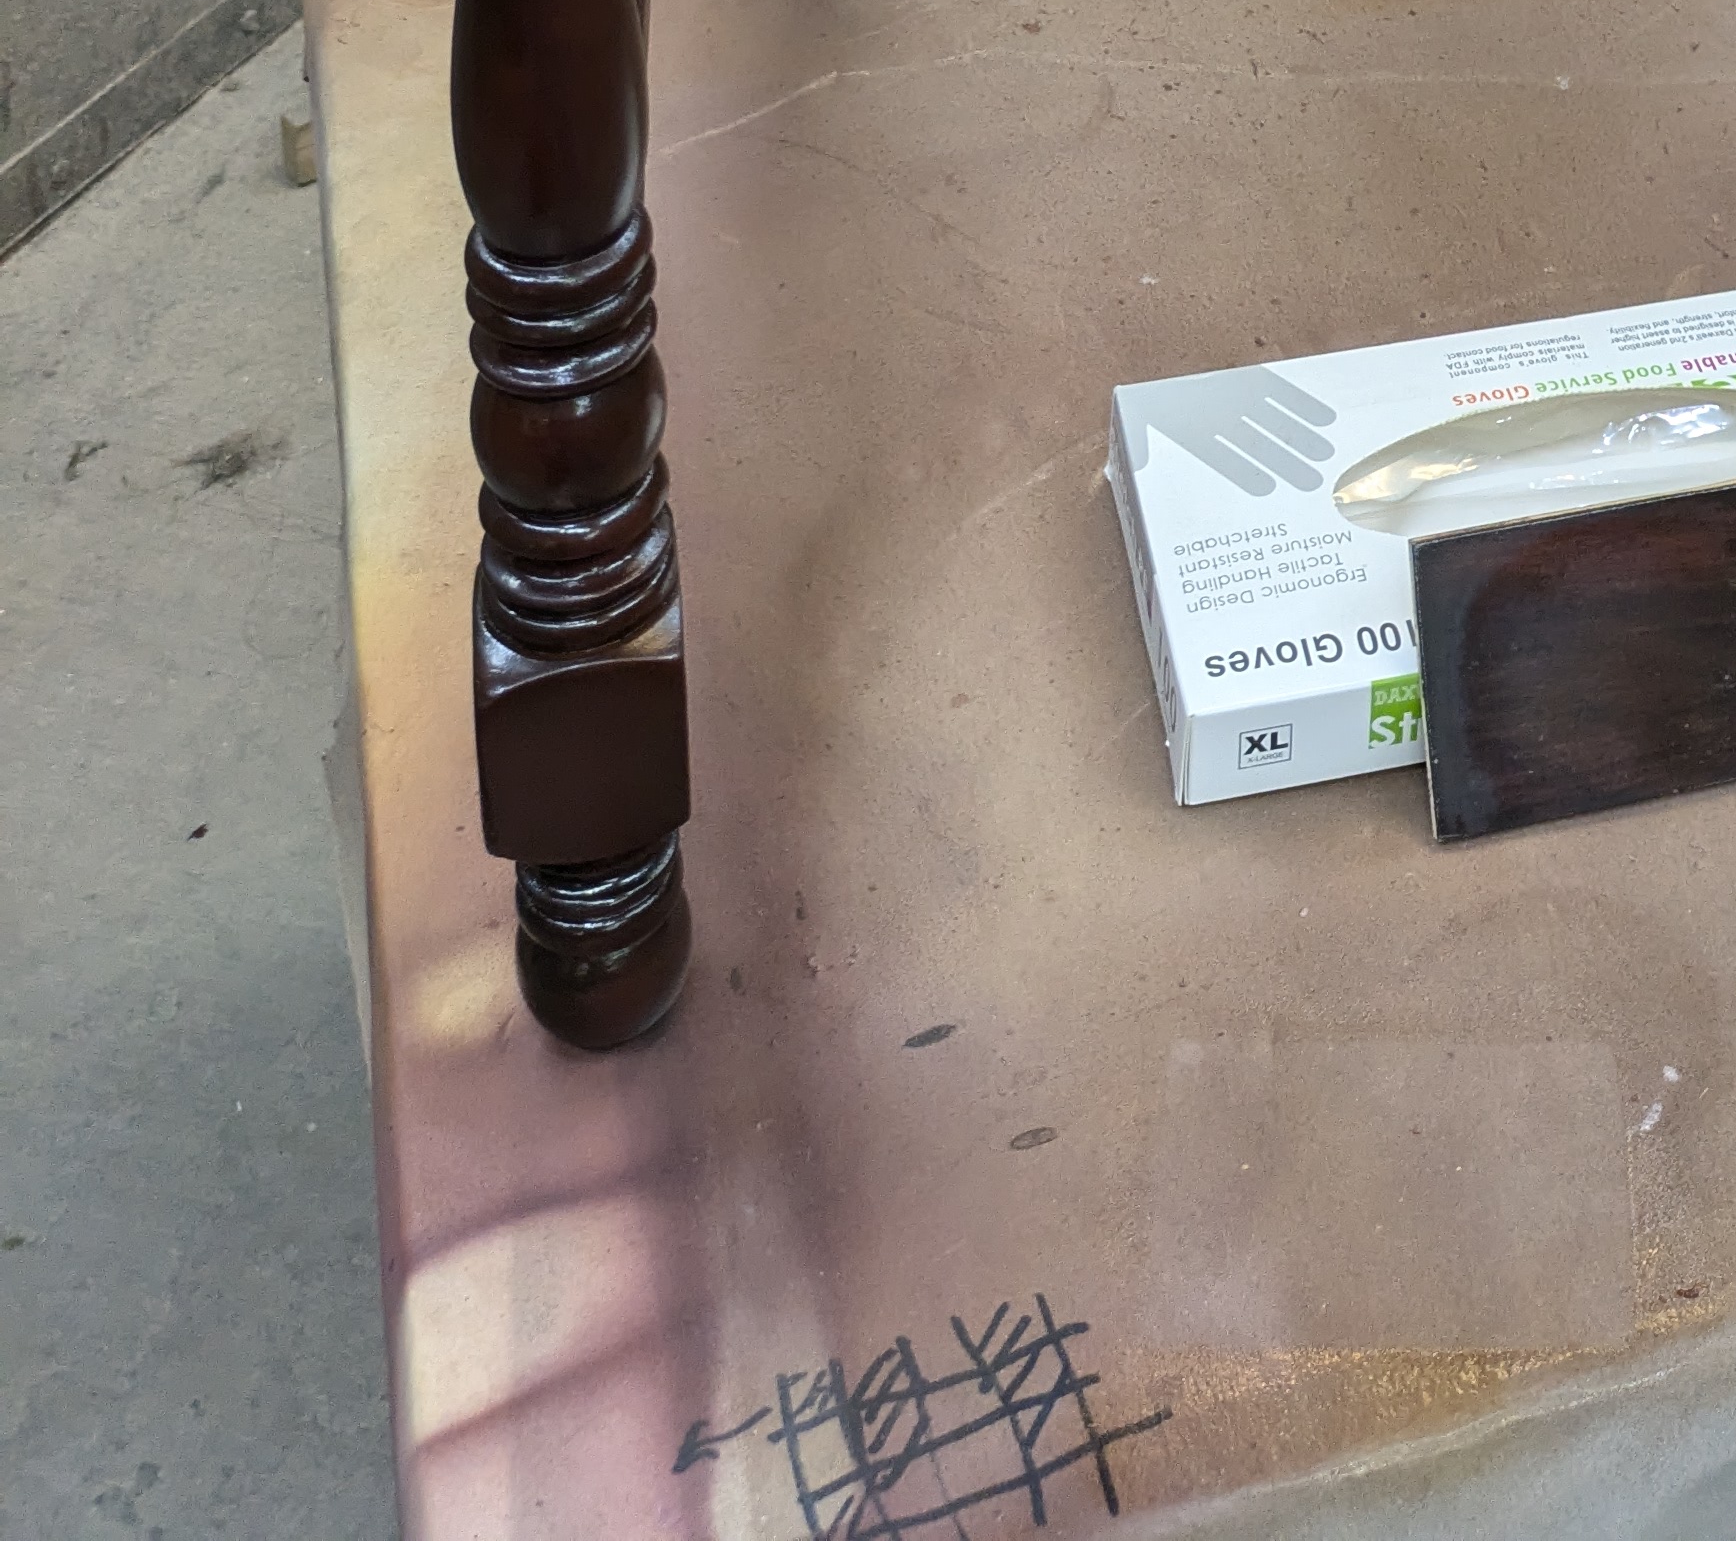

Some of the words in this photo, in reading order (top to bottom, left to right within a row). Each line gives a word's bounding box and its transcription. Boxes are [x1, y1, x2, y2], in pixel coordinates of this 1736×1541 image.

[1445, 360, 1469, 371] FDA
[1448, 363, 1511, 378] component
[1622, 363, 1677, 384] Food
[1535, 372, 1618, 393] Service
[1452, 385, 1530, 407] Gloves
[1173, 522, 1289, 556] Stretchable
[1271, 530, 1353, 556] Moisture
[1178, 545, 1264, 577] Resistant
[1278, 552, 1344, 574] Tactile
[1182, 565, 1271, 595] Handling
[1261, 566, 1368, 598] Ergonomic
[1186, 589, 1255, 614] Design
[1204, 632, 1343, 678] Gloves
[1243, 731, 1289, 756] XL
[1247, 750, 1285, 764] X-LARGE
